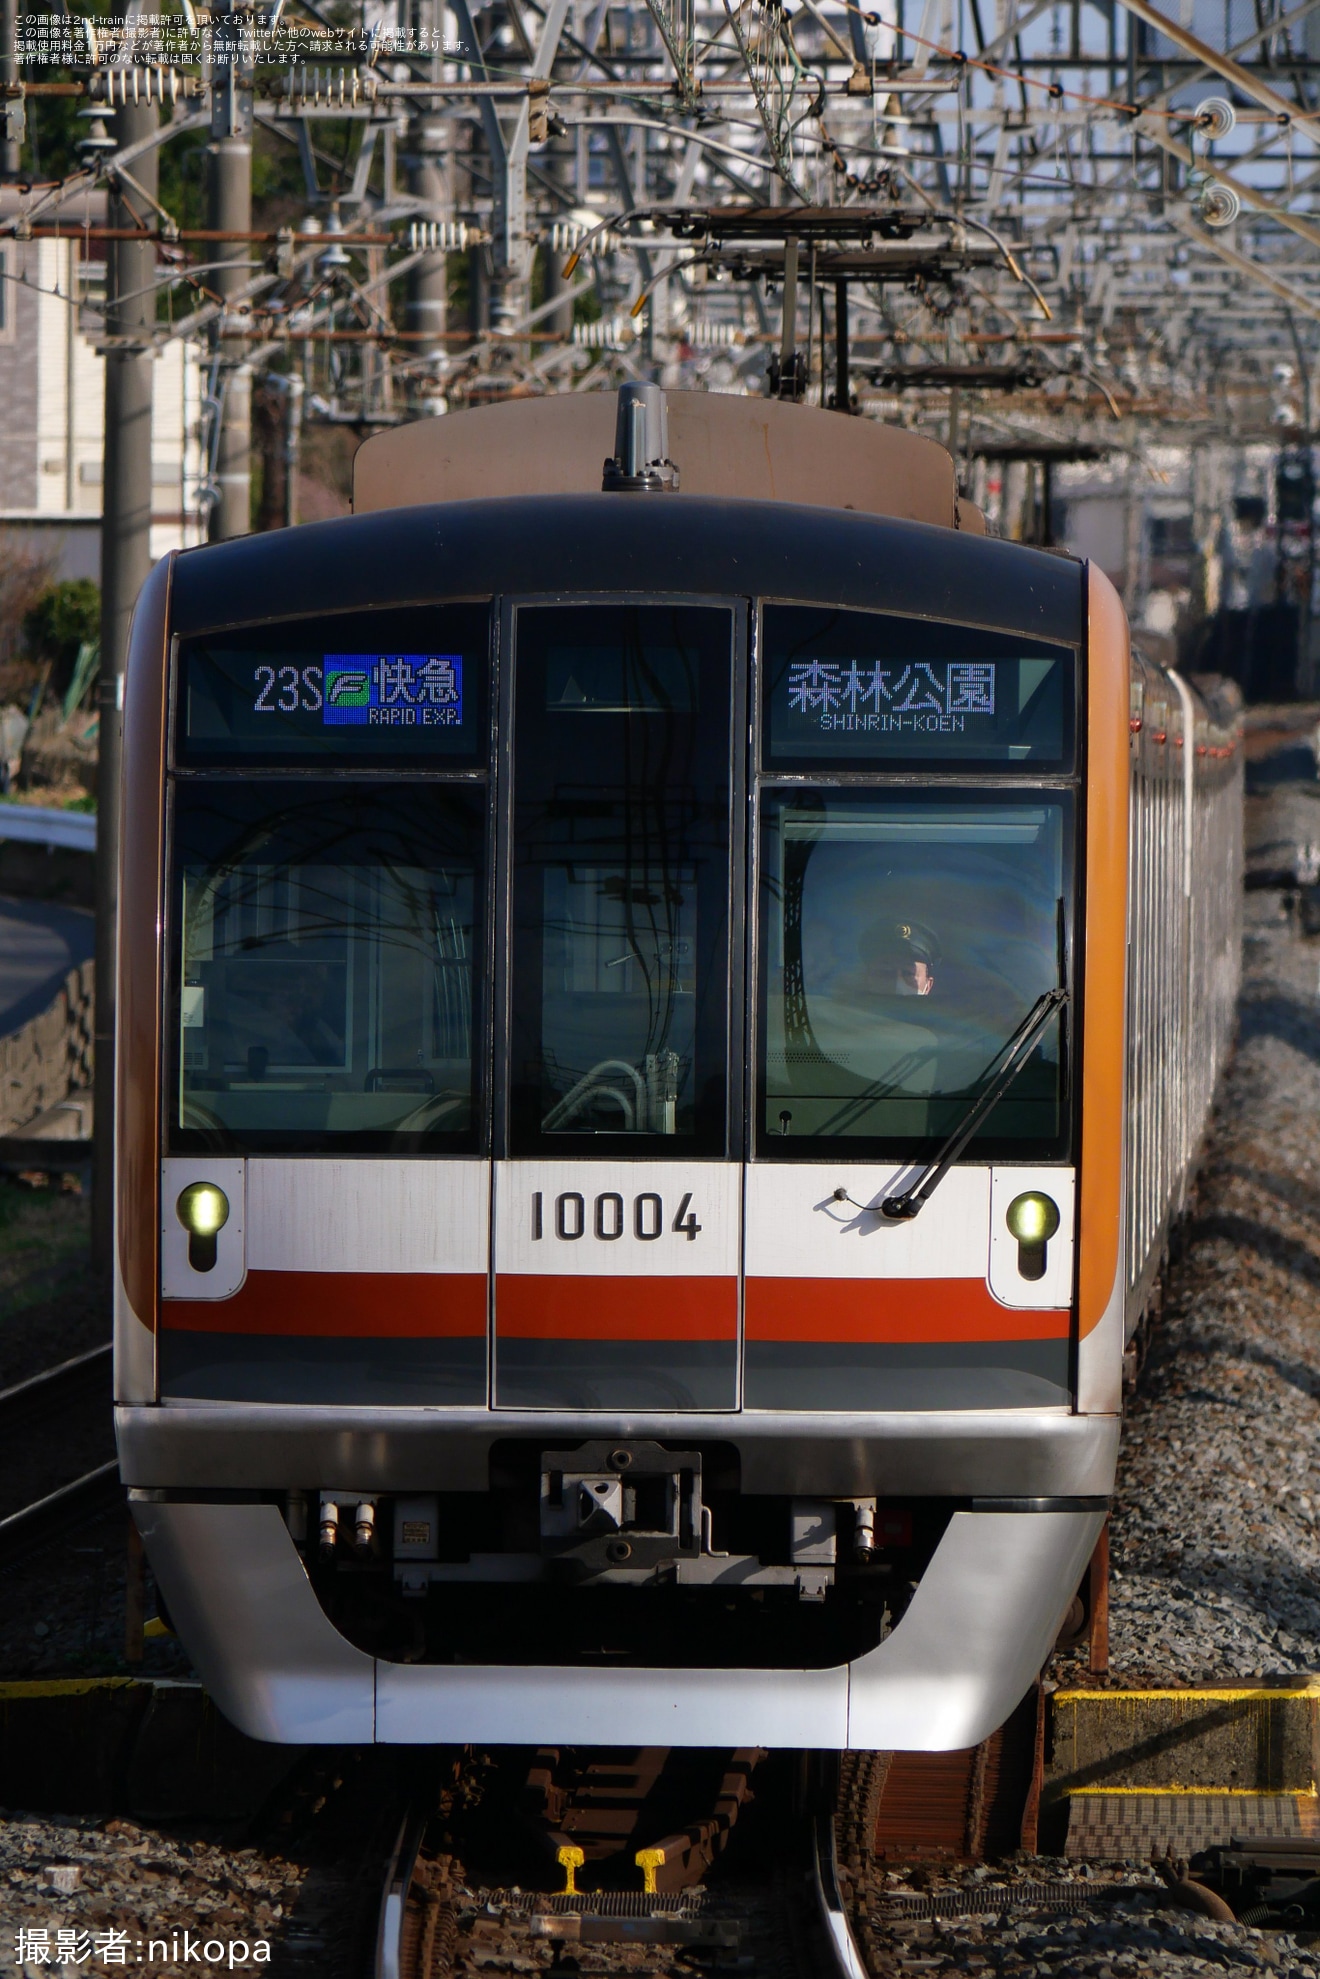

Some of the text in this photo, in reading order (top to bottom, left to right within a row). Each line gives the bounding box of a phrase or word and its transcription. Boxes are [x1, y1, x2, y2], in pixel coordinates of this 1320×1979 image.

[254, 666, 323, 711] 23S
[373, 658, 459, 703] 快急
[788, 659, 996, 714] 森林公園
[369, 708, 461, 724] RAPID EXP.
[820, 714, 965, 731] SHINRIN-KOEN
[531, 1191, 702, 1241] 10004
